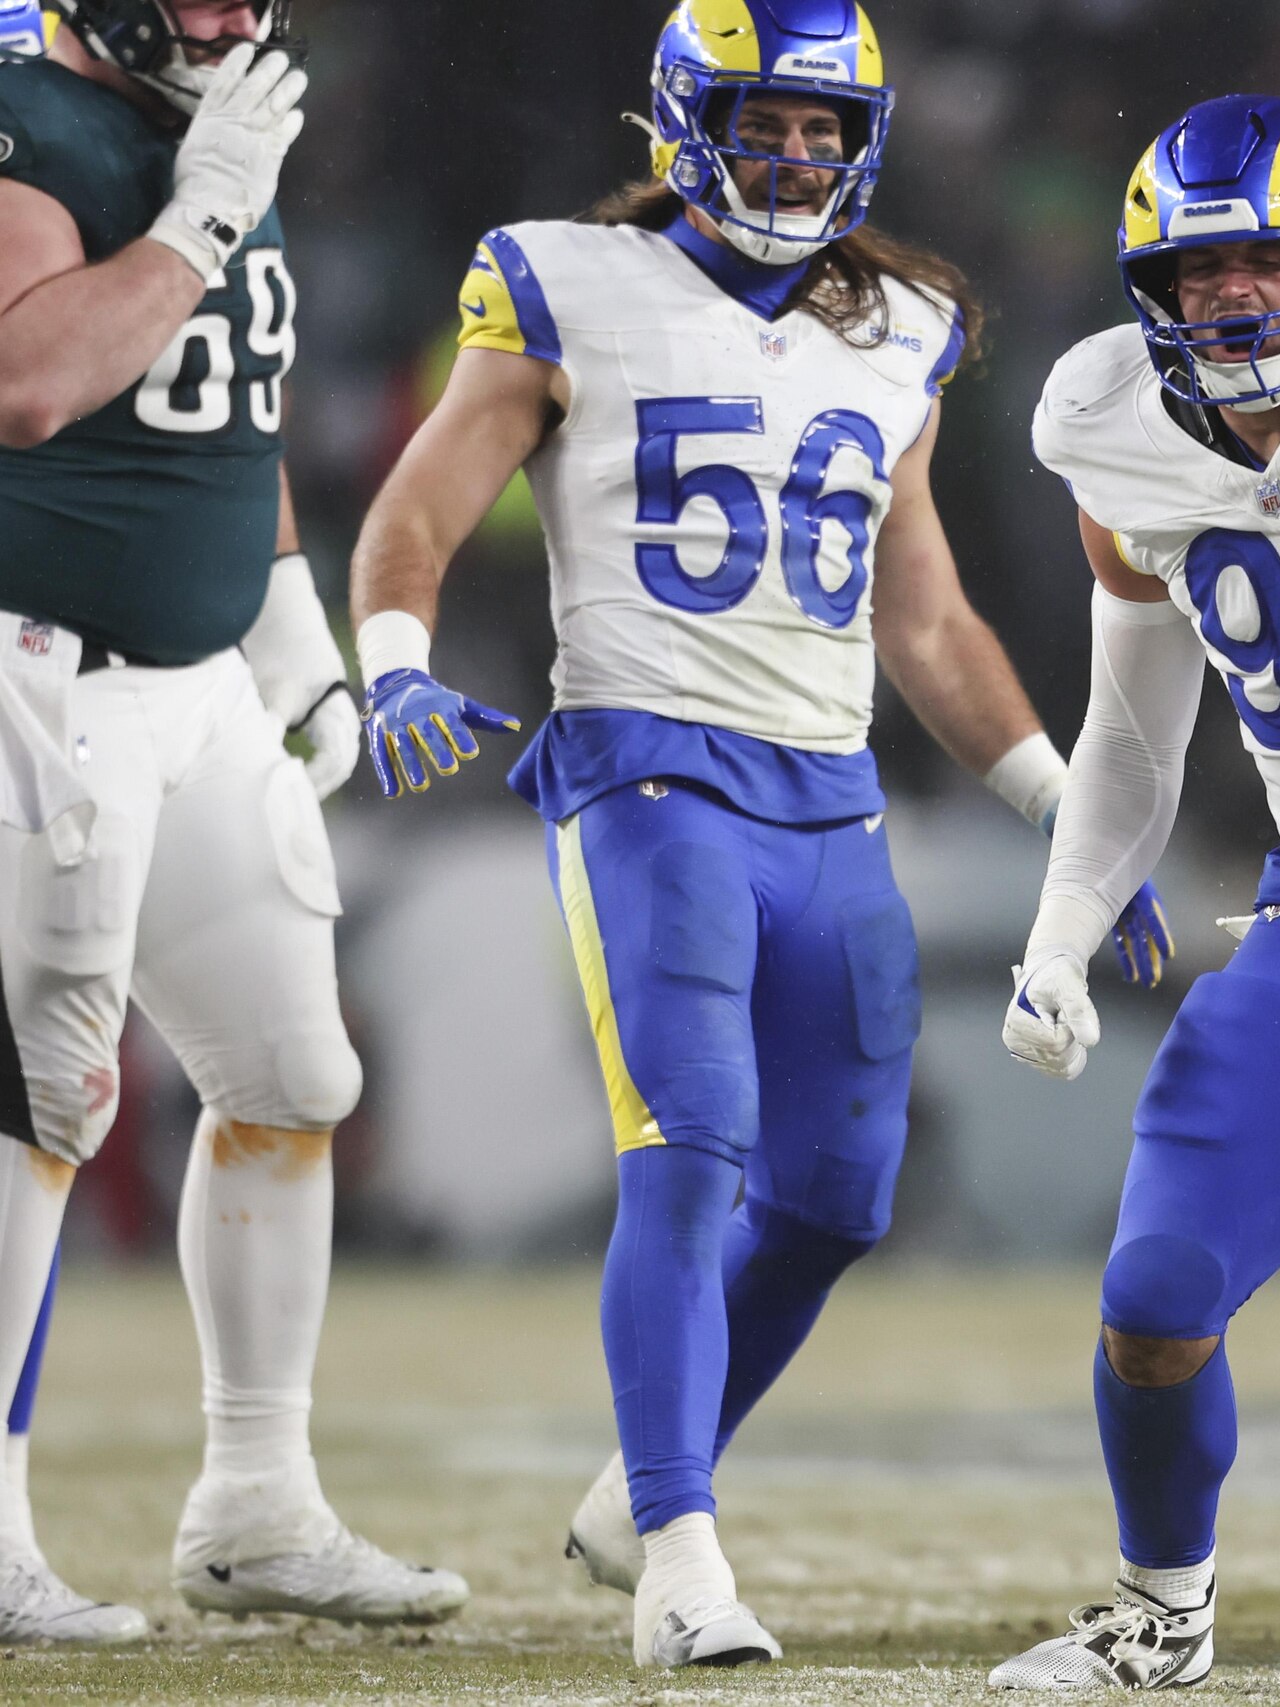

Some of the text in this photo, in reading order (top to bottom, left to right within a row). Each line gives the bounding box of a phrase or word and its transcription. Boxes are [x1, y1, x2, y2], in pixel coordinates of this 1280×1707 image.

[792, 59, 838, 71] RAMS
[634, 395, 891, 630] 56
[22, 632, 48, 655] NFL
